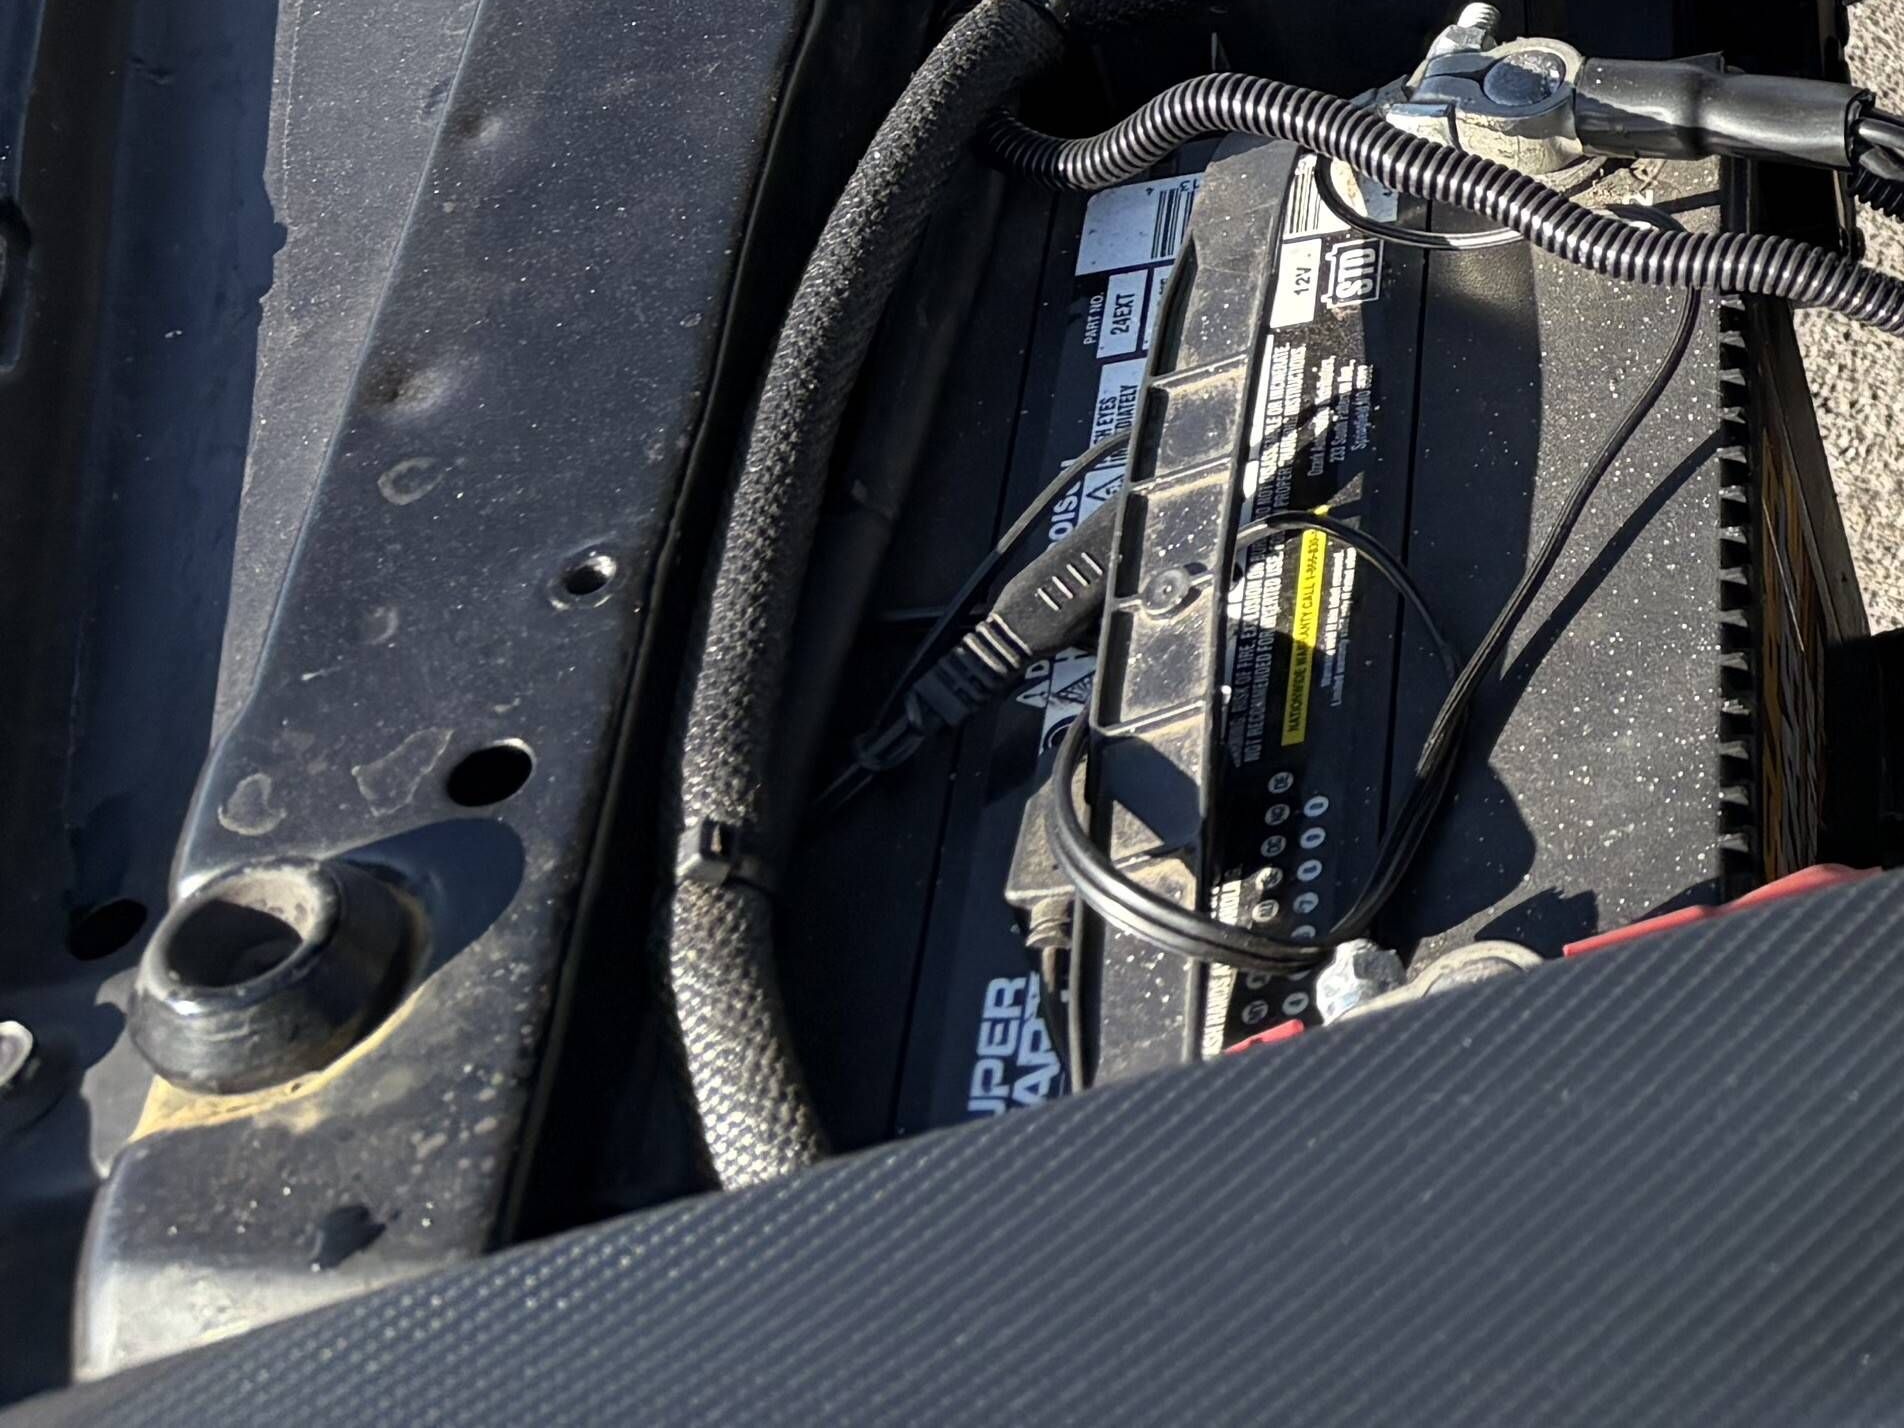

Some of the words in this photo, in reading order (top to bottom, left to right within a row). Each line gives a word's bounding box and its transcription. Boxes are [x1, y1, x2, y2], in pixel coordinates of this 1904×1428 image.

[1293, 265, 1311, 296] 12V
[1335, 246, 1376, 299] STD
[1089, 291, 1105, 313] NO.
[1110, 292, 1136, 334] 24EXT
[1083, 317, 1100, 343] PART
[1096, 396, 1117, 425] EYES
[1108, 383, 1138, 460] IMDIATELY
[1328, 445, 1345, 462] 233
[1272, 467, 1292, 507] PROPER
[1285, 666, 1307, 734] NATIONWIDE
[1300, 581, 1315, 611] CALL
[1199, 1022, 1225, 1060] ASH
